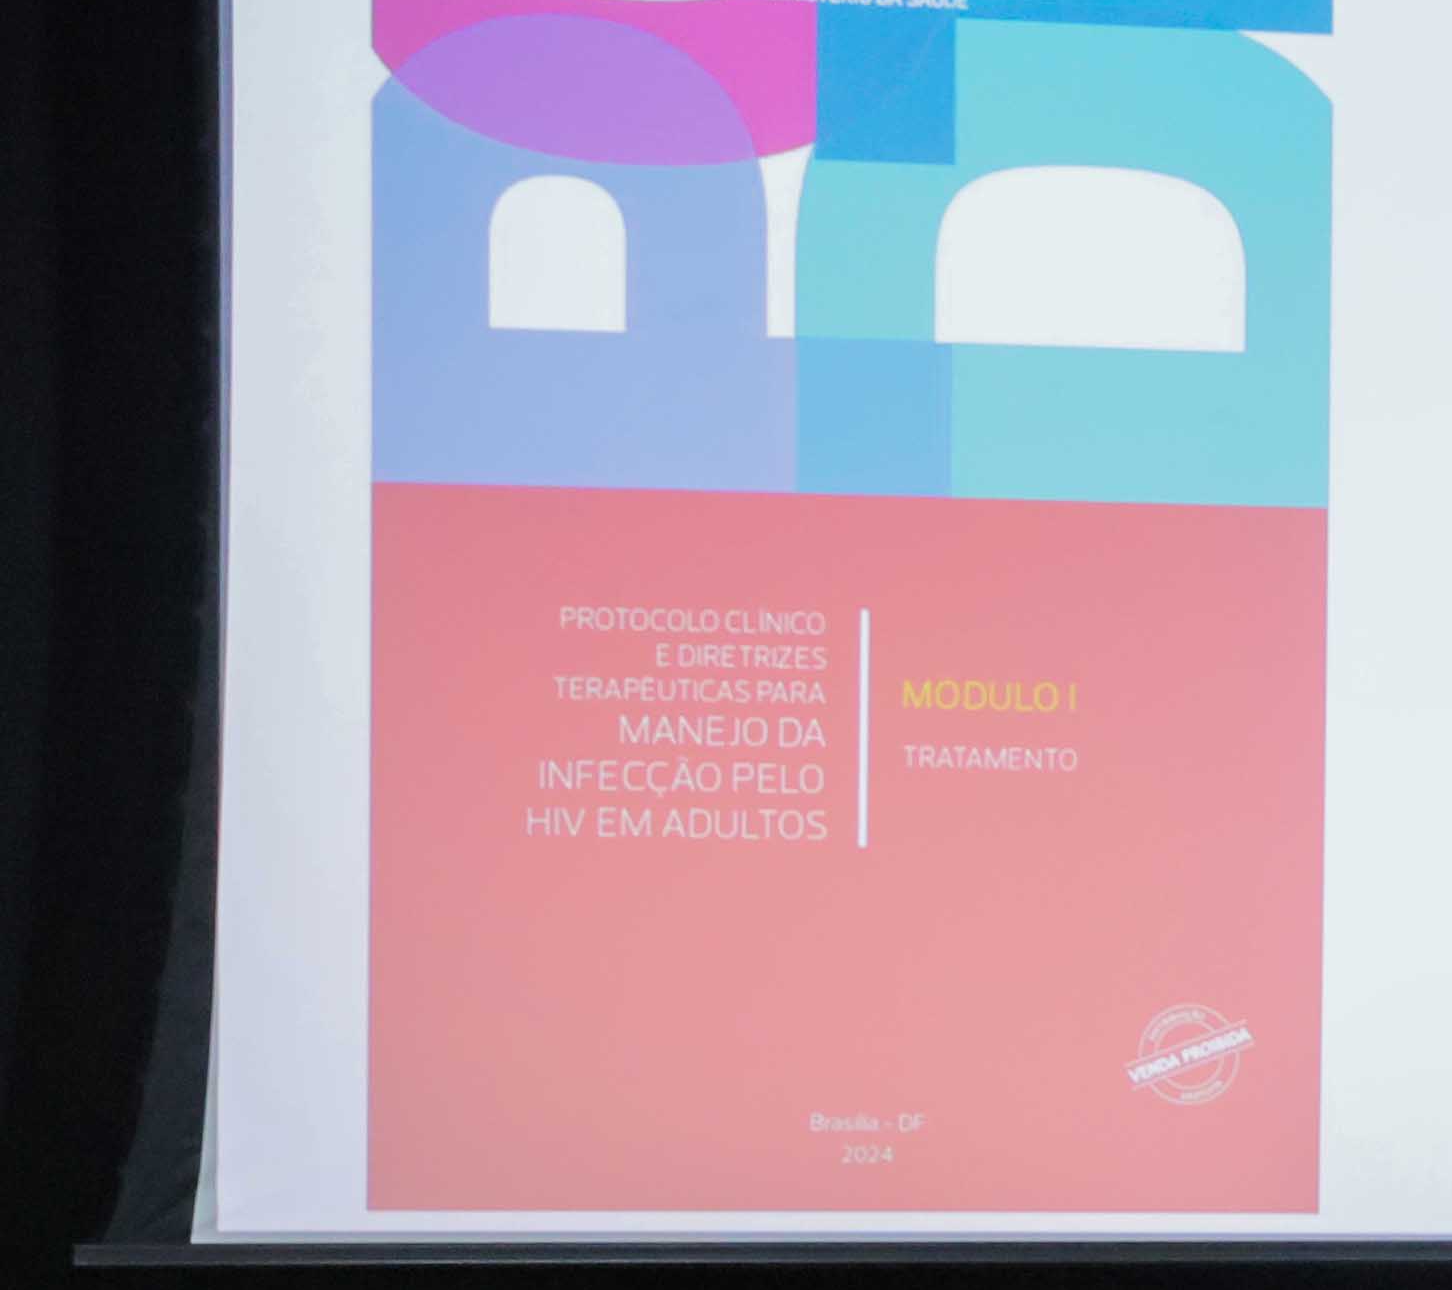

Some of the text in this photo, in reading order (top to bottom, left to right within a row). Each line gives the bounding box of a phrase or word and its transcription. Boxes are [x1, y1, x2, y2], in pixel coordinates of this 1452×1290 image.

[559, 605, 720, 633] PROTOCOLO
[655, 642, 829, 671] E DIRETRIZES
[755, 680, 828, 705] PARA
[1068, 681, 1078, 713] I
[618, 713, 827, 748] MANEJO DA
[903, 743, 1079, 773] TRATAMENTO
[537, 756, 826, 798] INFECÇÃO PELO
[525, 806, 829, 842] HIV EM ADULTOS
[898, 1112, 927, 1132] DF
[841, 1144, 895, 1165] 2024
